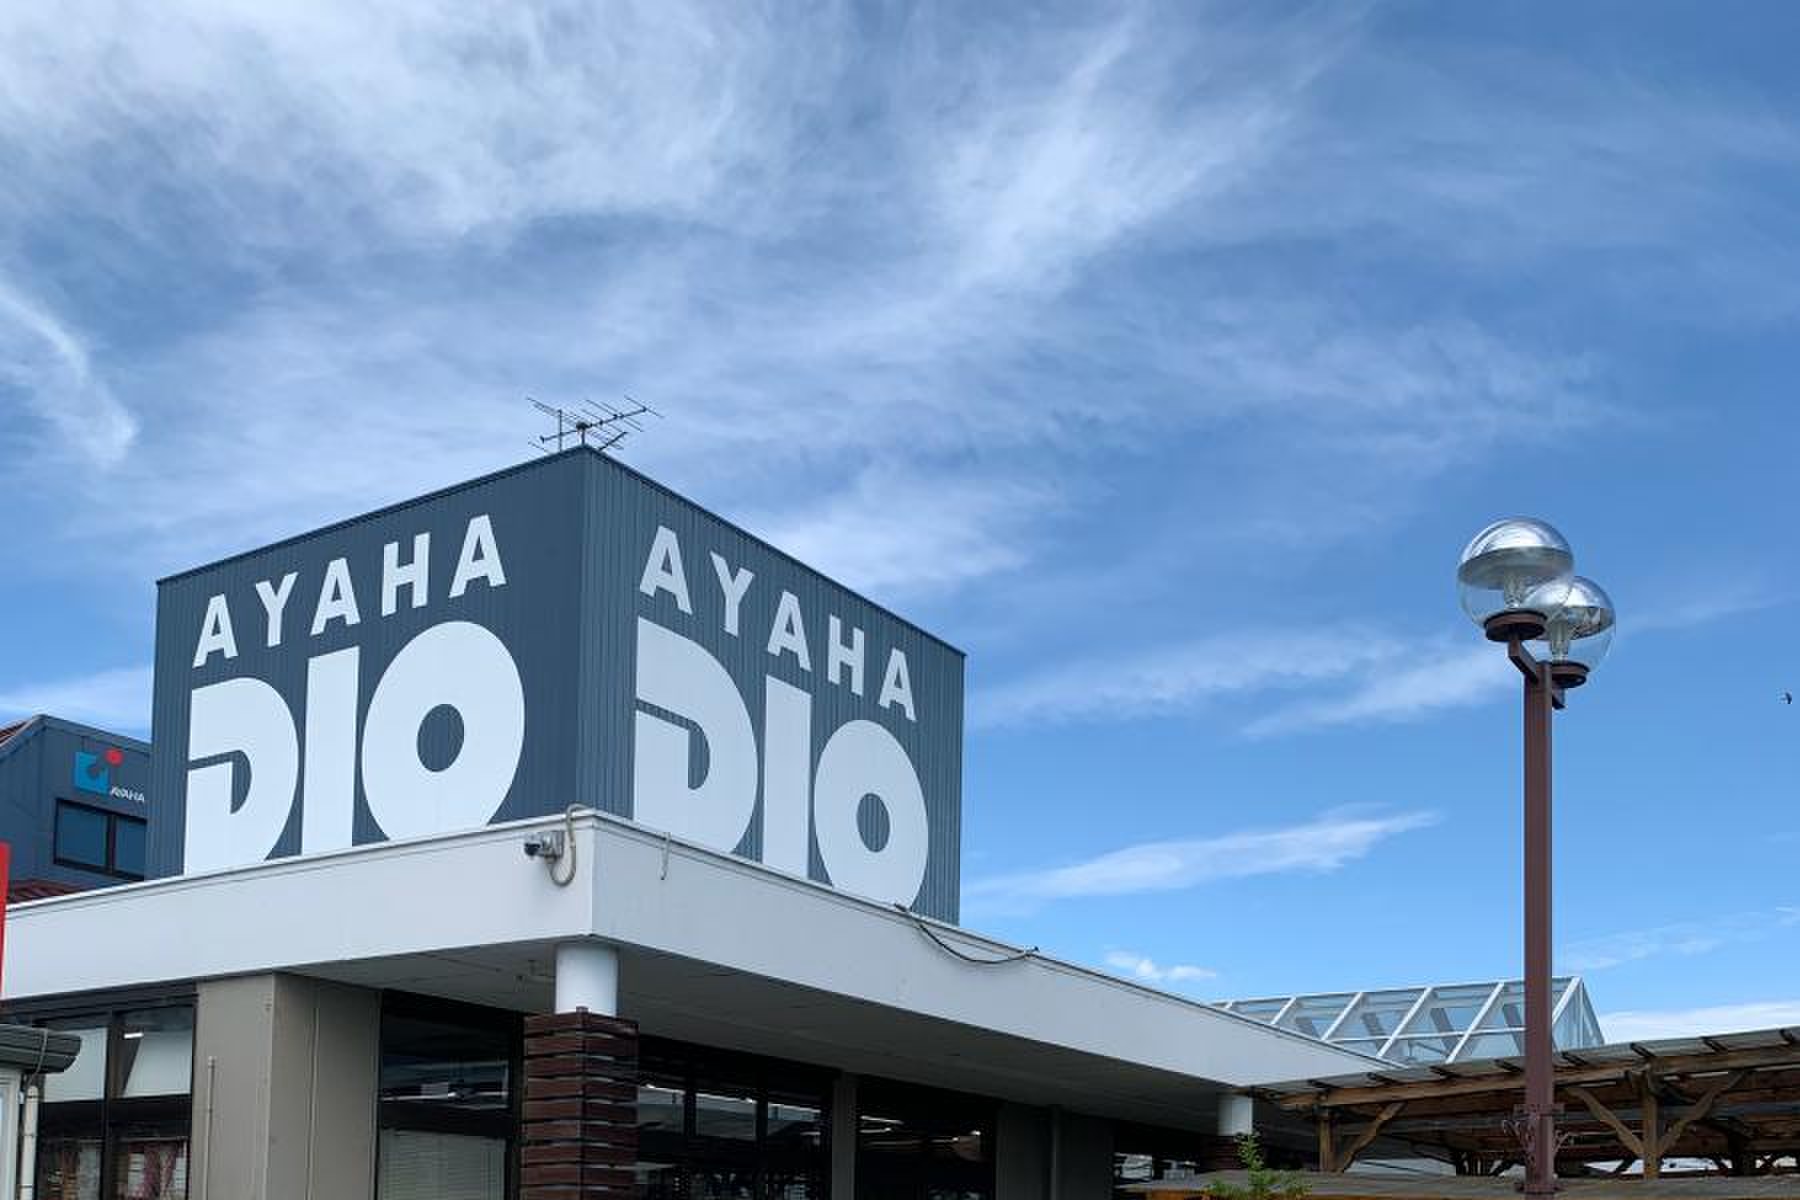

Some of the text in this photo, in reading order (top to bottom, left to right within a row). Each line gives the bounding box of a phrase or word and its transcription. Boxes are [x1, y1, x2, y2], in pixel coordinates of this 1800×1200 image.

[192, 514, 507, 669] AYAHA
[639, 525, 917, 722] AYAHA
[183, 620, 526, 876] DIO
[633, 615, 929, 912] DIO
